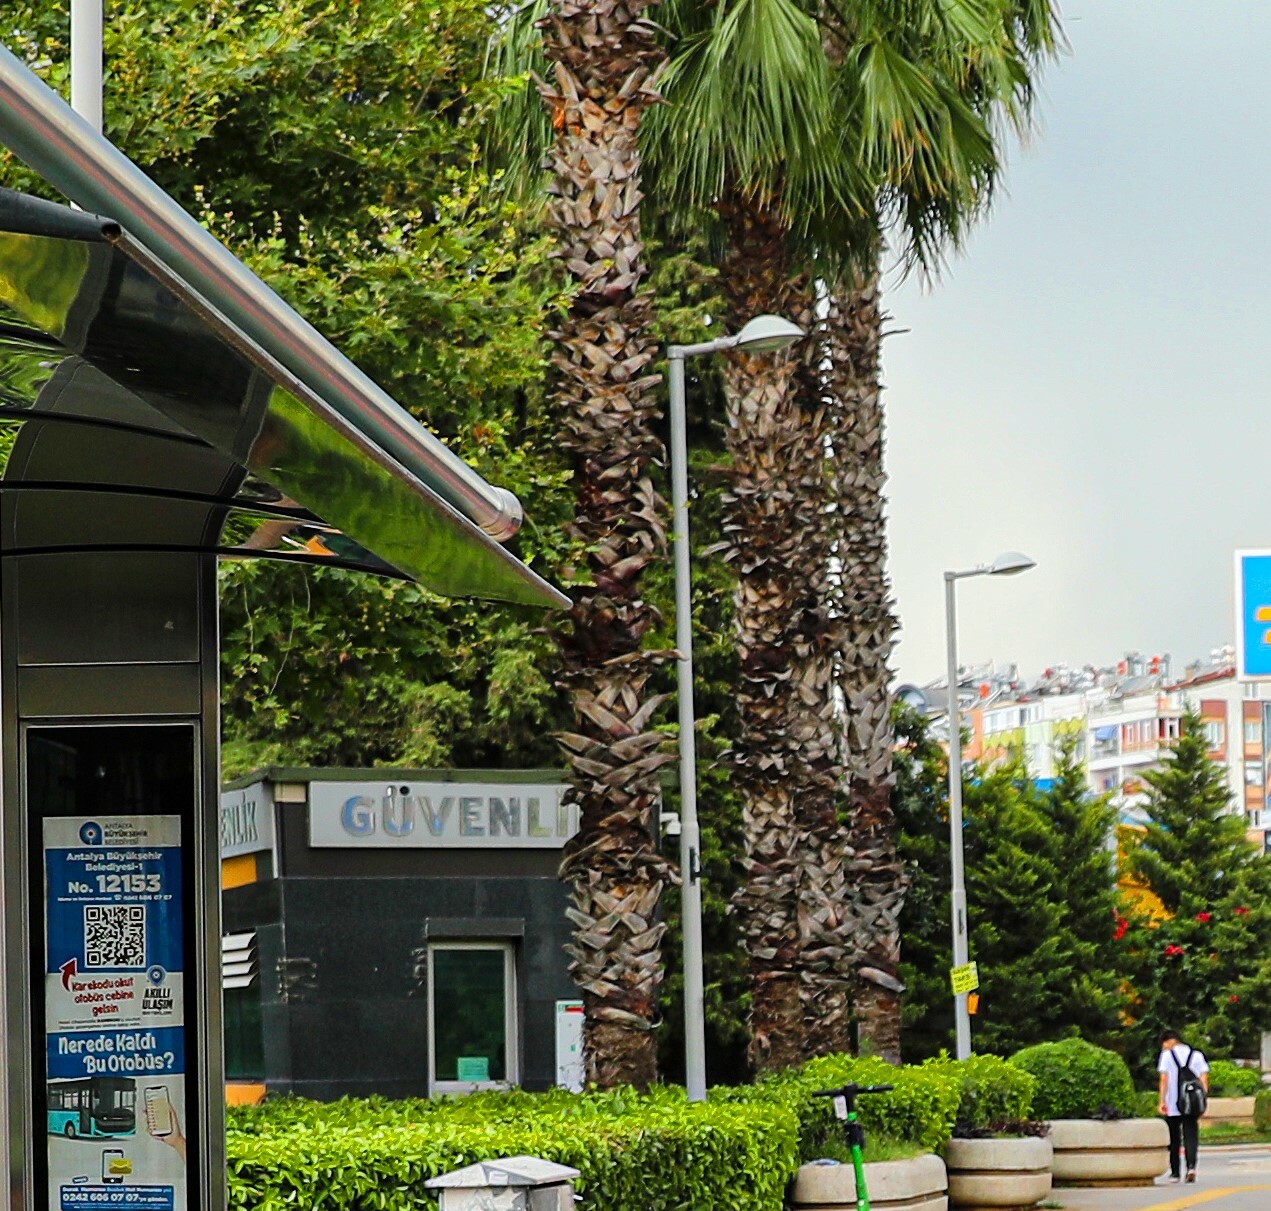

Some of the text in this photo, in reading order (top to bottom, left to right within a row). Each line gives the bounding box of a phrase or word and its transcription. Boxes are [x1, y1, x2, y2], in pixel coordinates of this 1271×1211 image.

[341, 785, 582, 837] GÜVENLİ
[66, 852, 105, 862] Antalya
[68, 874, 161, 894] No. 12153
[115, 977, 134, 988] okut
[74, 990, 134, 1004] otobüs cebine
[144, 988, 170, 998] AKILLI
[92, 1004, 119, 1017] gelsin
[116, 1033, 156, 1052] Kaldı
[83, 1052, 175, 1074] Bu Otobüs?
[62, 1193, 89, 1202] 0242
[90, 1193, 109, 1202] 606
[110, 1193, 125, 1202] 07
